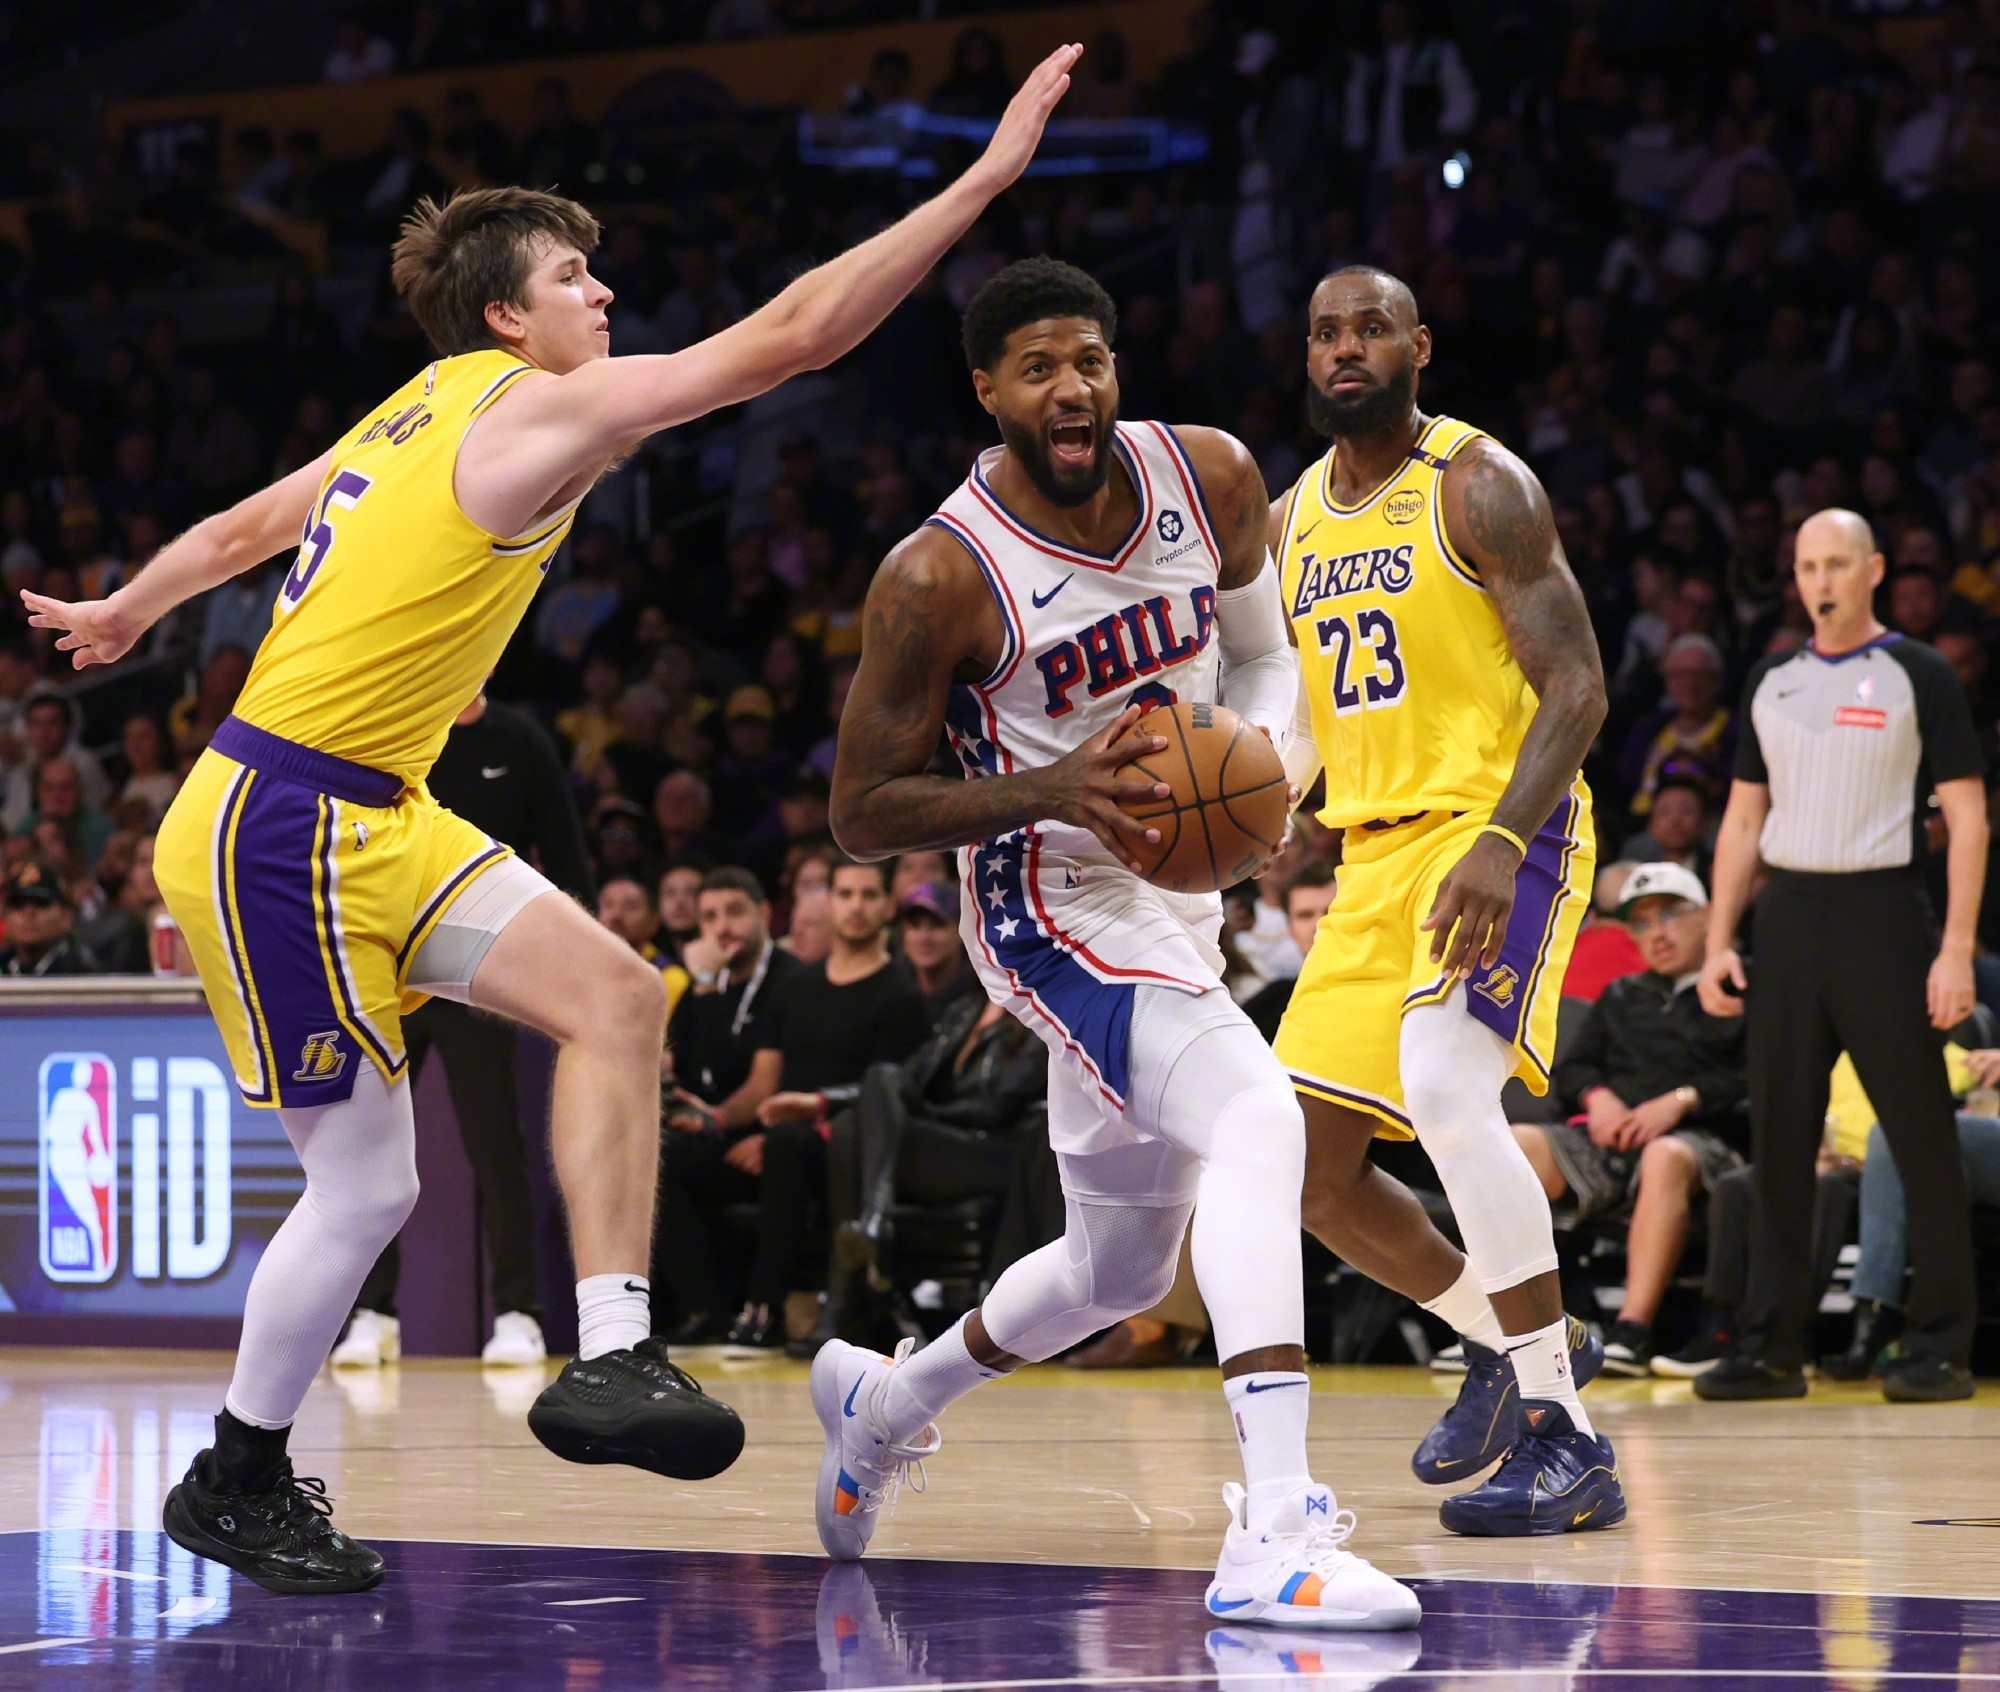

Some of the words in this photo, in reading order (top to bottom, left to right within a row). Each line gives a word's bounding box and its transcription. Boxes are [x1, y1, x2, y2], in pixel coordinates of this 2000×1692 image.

[1387, 499, 1423, 514] bibigo
[1155, 538, 1202, 566] crypto.com
[1291, 544, 1414, 620] LAKERS
[1316, 607, 1408, 718] 23
[131, 1056, 232, 1280] iD
